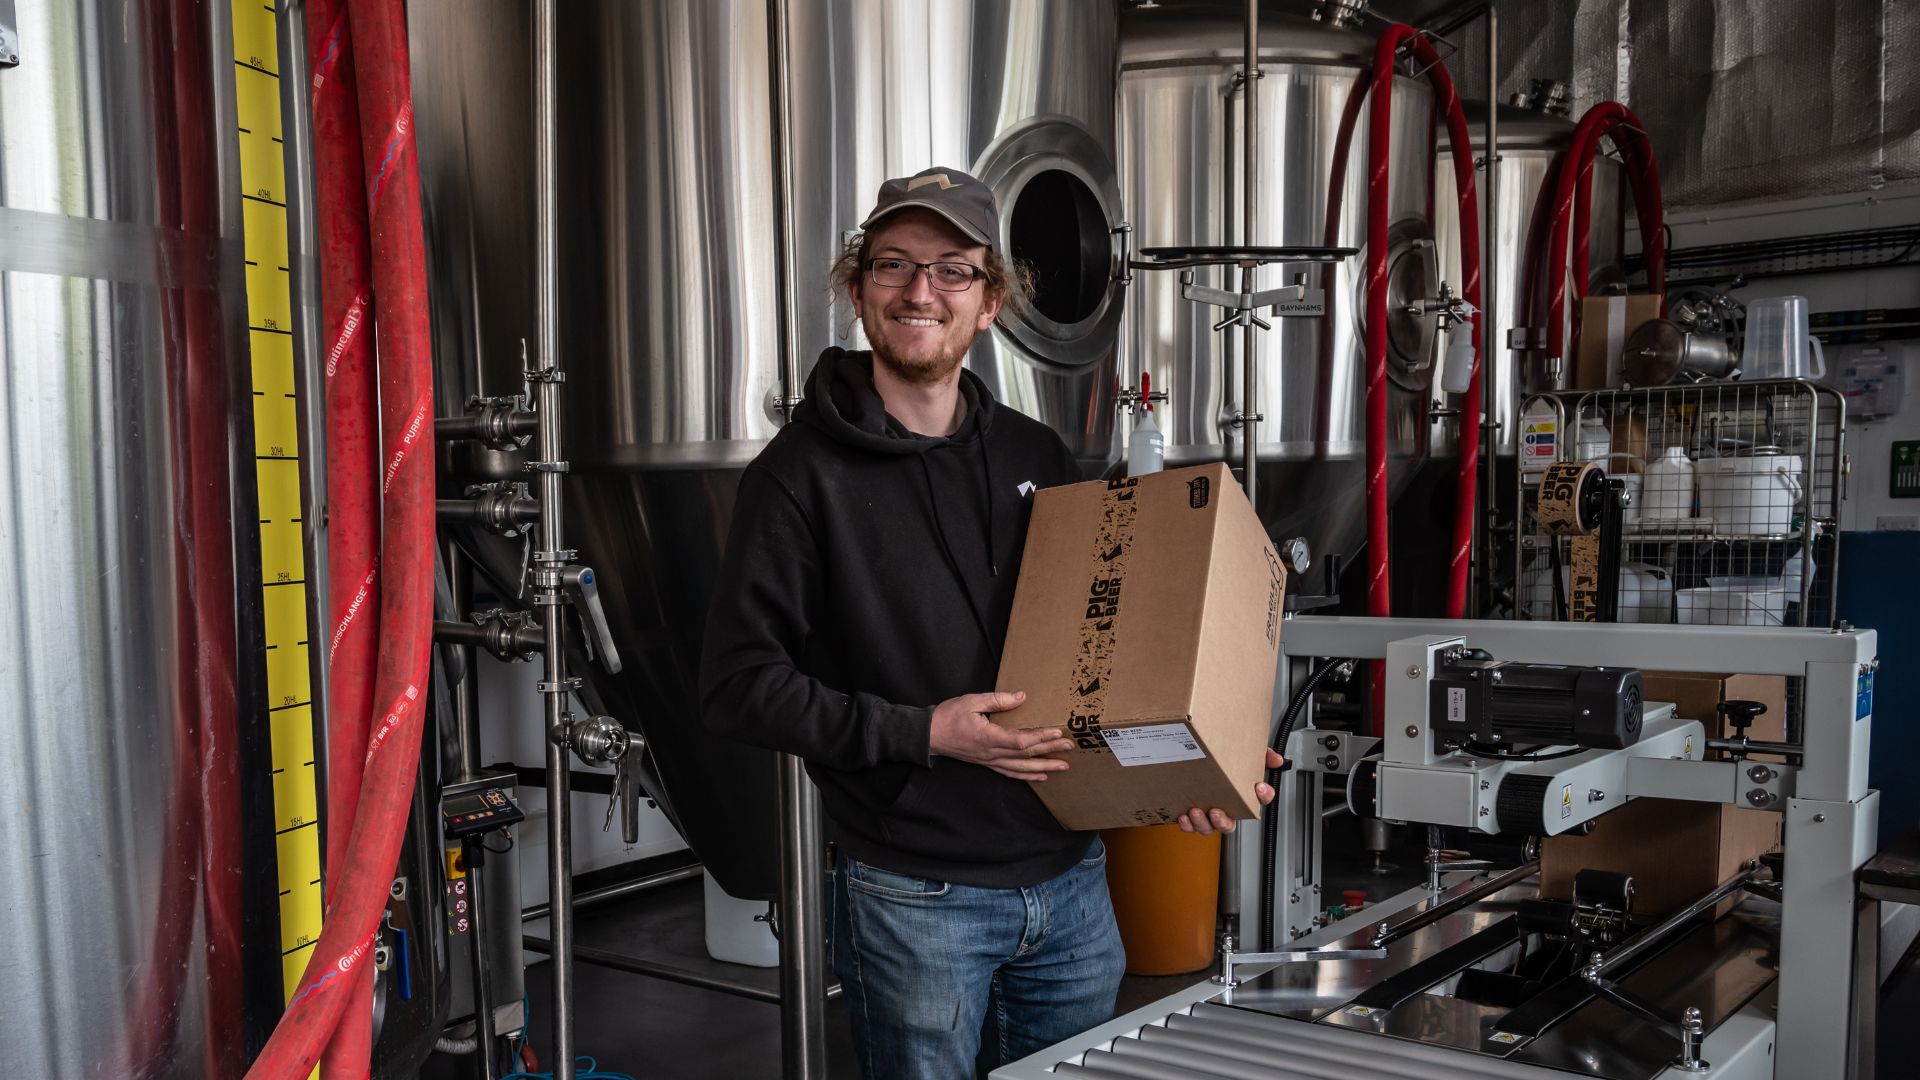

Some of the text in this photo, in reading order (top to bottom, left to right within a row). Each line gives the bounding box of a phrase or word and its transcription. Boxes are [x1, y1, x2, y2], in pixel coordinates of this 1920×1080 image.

[250, 56, 264, 69] 45HL
[257, 188, 272, 201] 40HL
[1280, 304, 1322, 312] BAYNHAMS
[264, 318, 278, 330] 35HL
[327, 314, 358, 376] Continental
[270, 446, 285, 457] 30HL
[1542, 466, 1562, 500] BEER
[1555, 466, 1582, 501] PIG
[277, 572, 292, 582] 25HL
[1086, 579, 1110, 619] PIG
[1104, 577, 1122, 616] BEER
[1265, 579, 1277, 641] FRAGILE
[1574, 590, 1585, 622] BEE
[284, 696, 298, 706] 20HL
[1067, 715, 1100, 748] PIG
[290, 817, 304, 828] 15HL
[297, 935, 310, 947] 10HL
